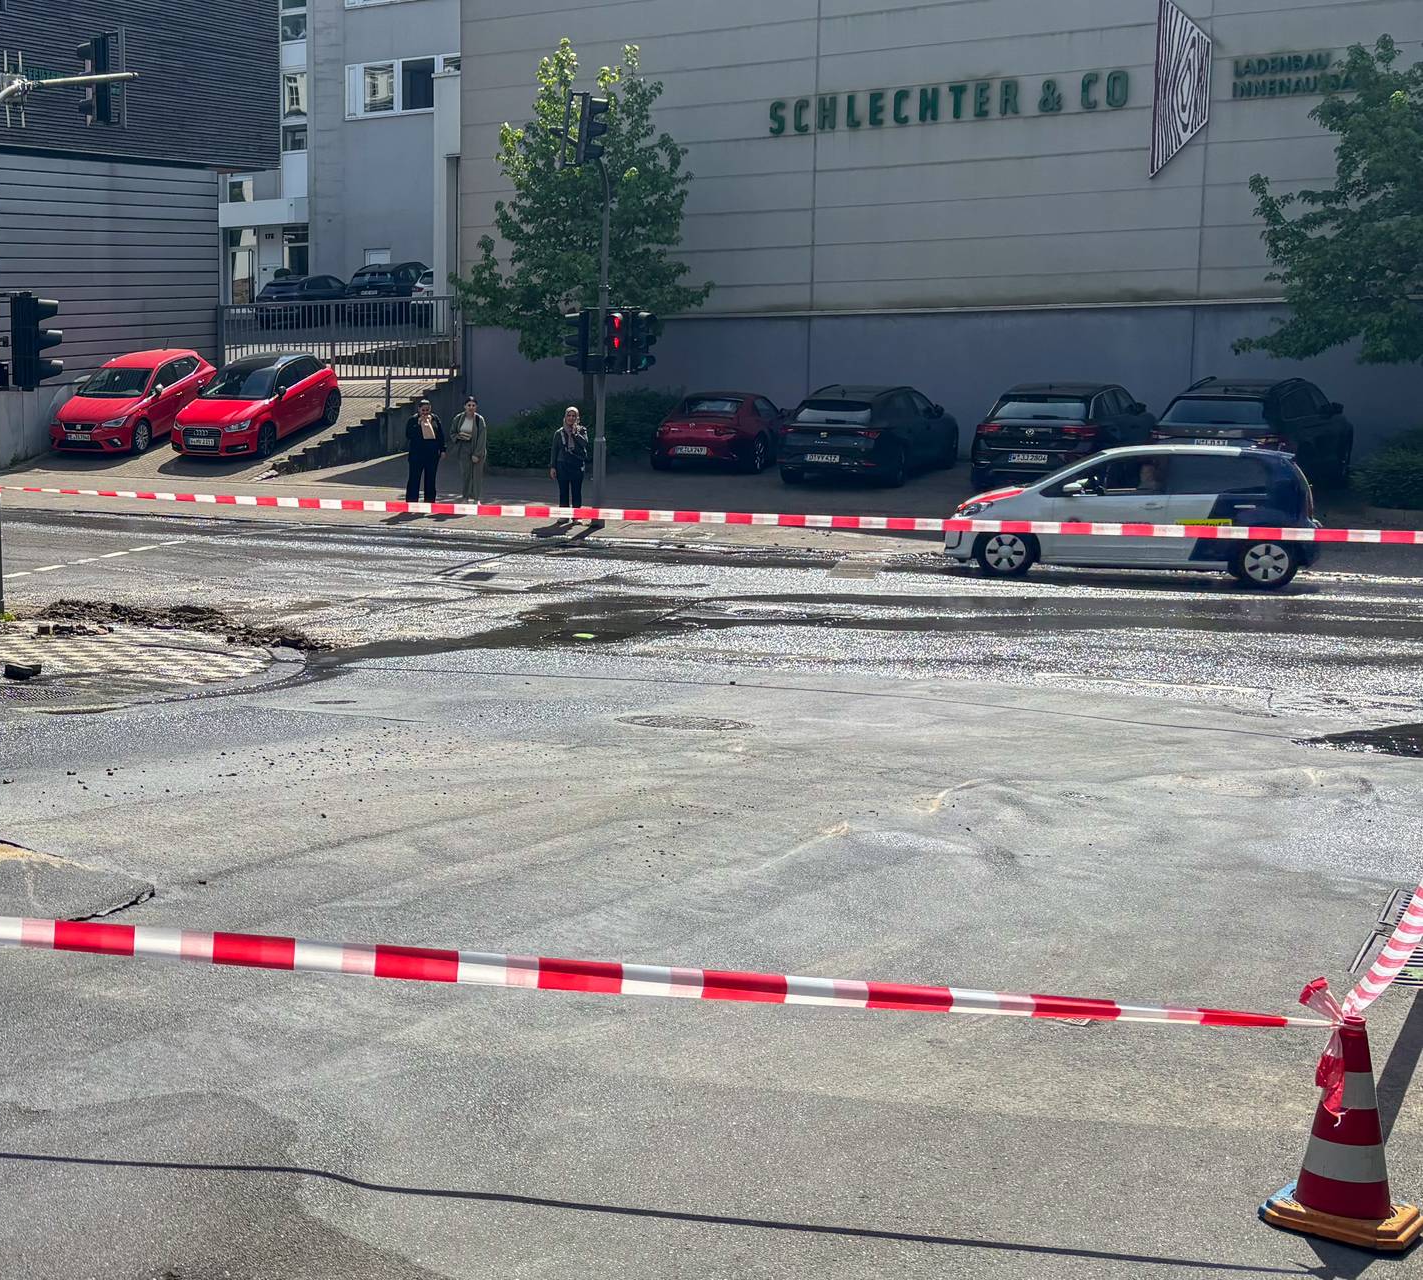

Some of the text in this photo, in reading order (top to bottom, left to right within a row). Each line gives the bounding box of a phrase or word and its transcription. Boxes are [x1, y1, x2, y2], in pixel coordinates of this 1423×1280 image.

[1233, 51, 1332, 78] LADENBAU
[769, 70, 1130, 136] SCHLECHTER & CO
